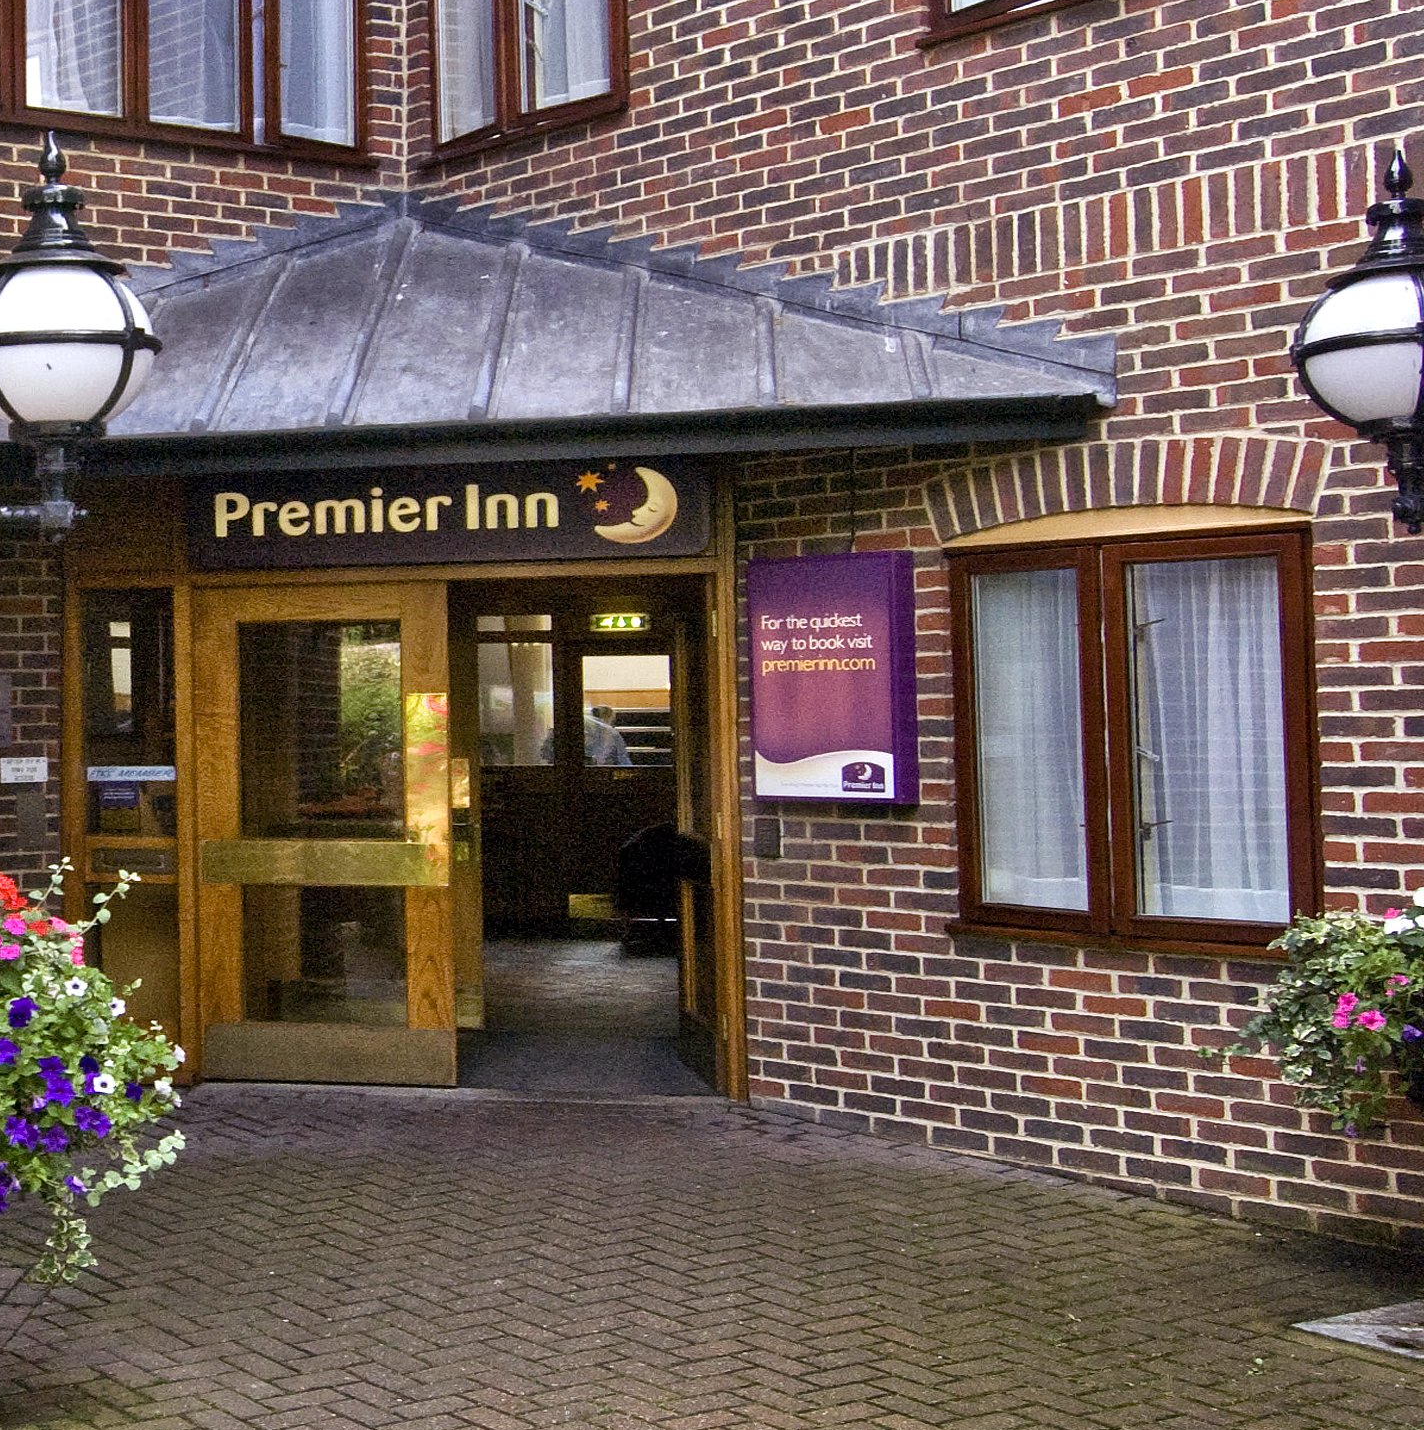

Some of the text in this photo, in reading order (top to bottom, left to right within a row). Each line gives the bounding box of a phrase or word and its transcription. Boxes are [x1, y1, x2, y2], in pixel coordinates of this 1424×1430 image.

[214, 484, 560, 538] Premier Inn
[761, 613, 863, 633] For the quickest
[761, 632, 874, 655] way to book visit
[762, 653, 876, 677] premierinn.com
[842, 781, 871, 790] Premier
